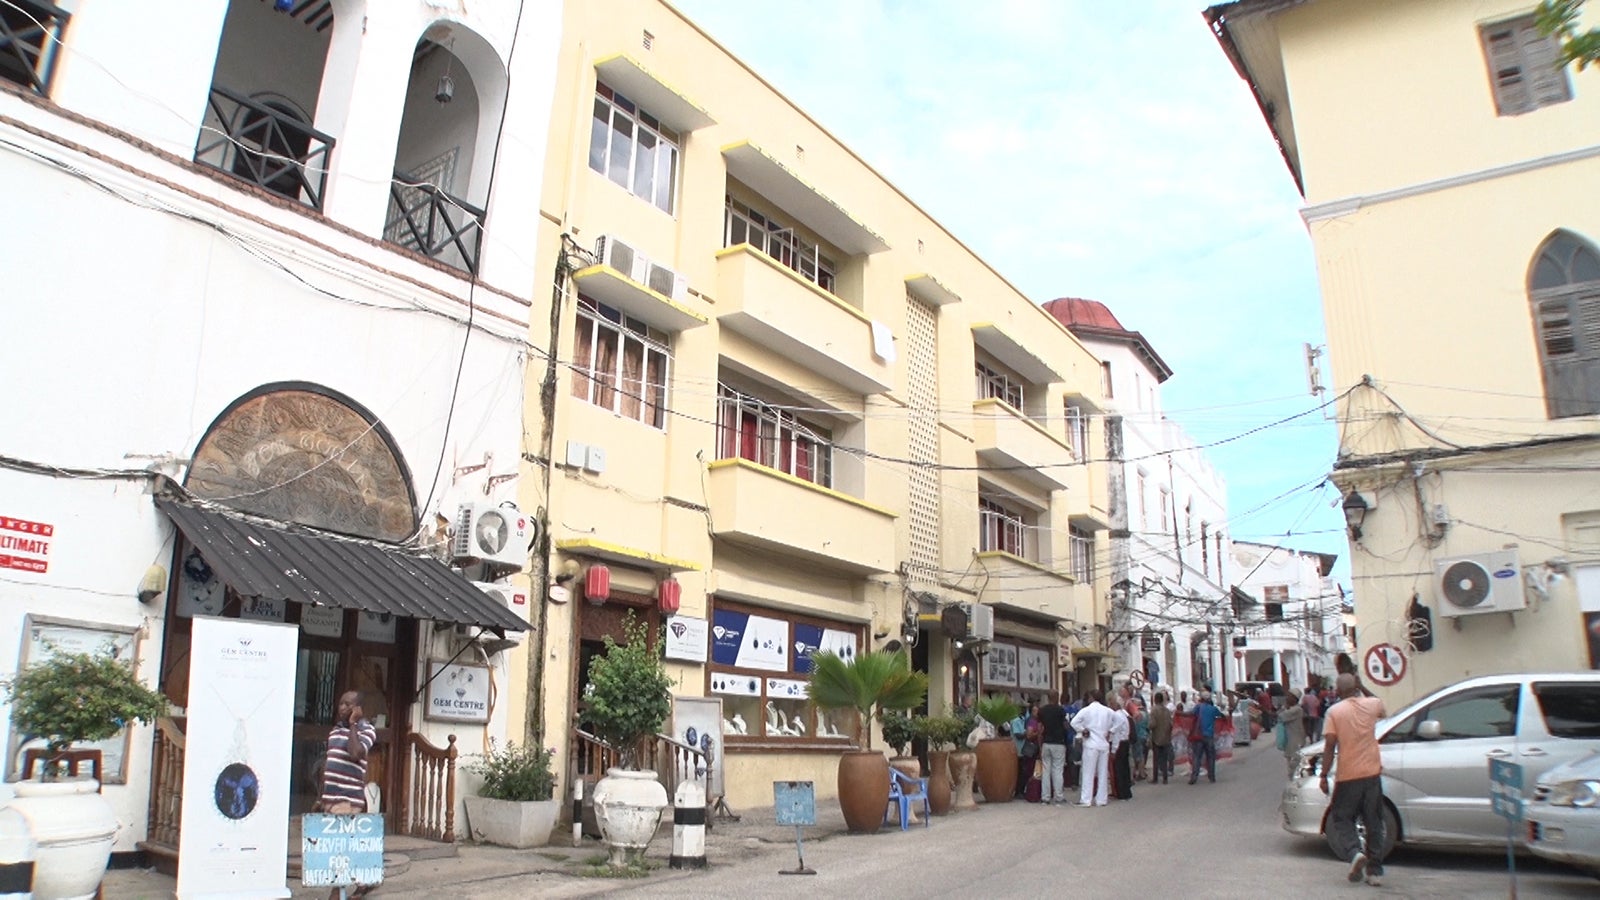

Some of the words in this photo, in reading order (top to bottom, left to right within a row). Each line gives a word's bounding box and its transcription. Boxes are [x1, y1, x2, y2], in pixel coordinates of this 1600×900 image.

[0, 535, 49, 555] LTIMATE
[433, 697, 451, 707] GEM
[453, 699, 485, 710] CENTRE
[321, 817, 373, 834] ZMC
[328, 855, 351, 869] FOR
